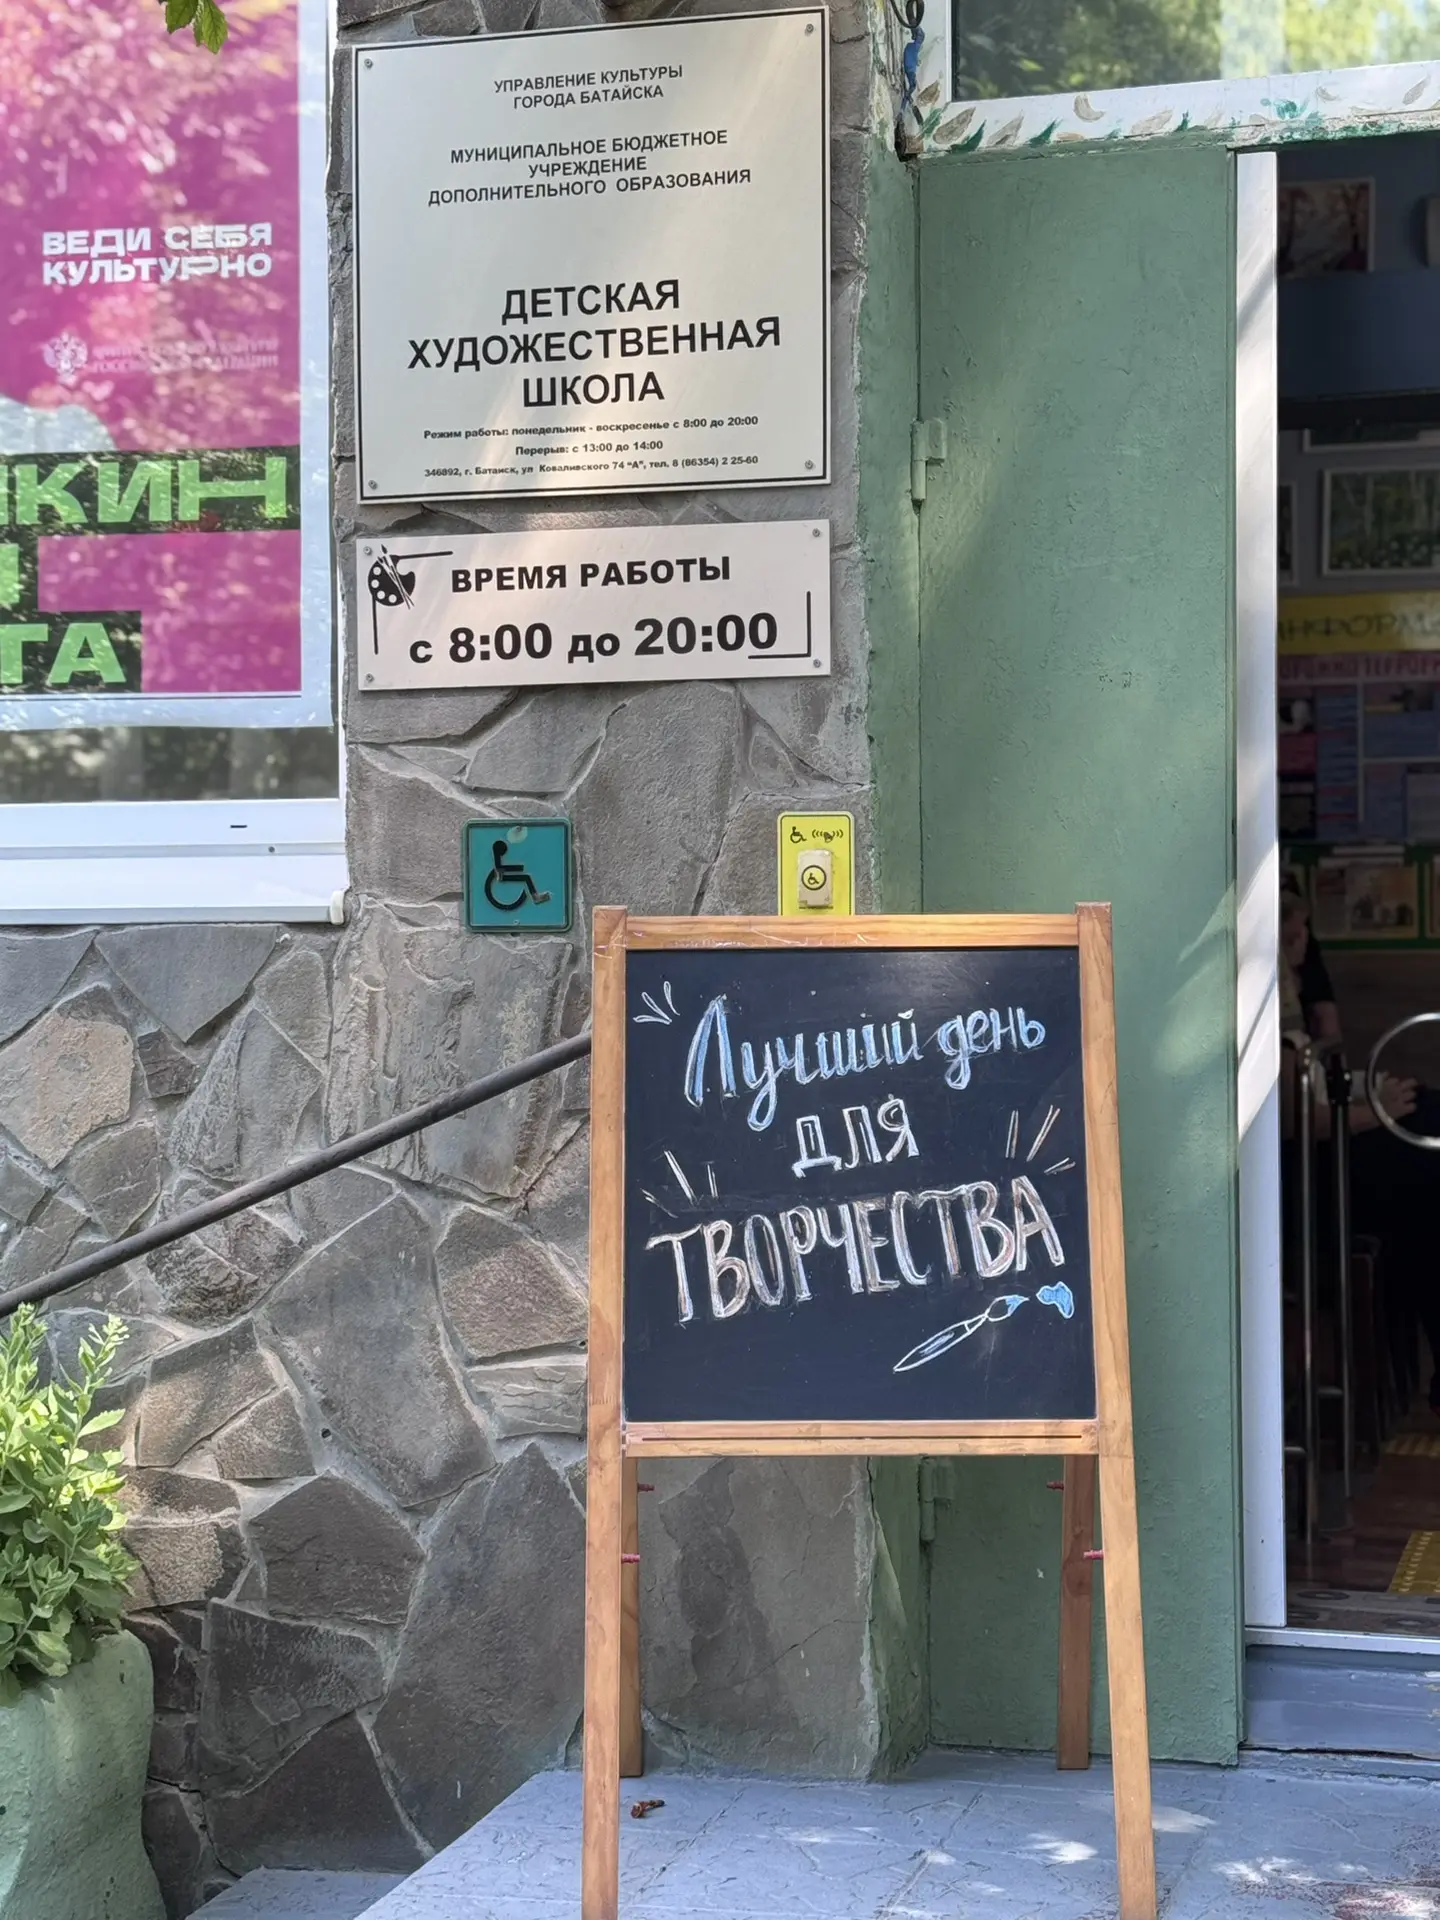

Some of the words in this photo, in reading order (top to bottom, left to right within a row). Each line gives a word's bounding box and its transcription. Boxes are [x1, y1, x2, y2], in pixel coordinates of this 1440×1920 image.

[494, 72, 597, 94] УПРАВЛЕНИЕ
[600, 64, 683, 86] КУЛЬТУРЫ
[513, 91, 576, 110] ГОРОДА
[580, 84, 664, 104] БАТАЙСКА
[450, 138, 607, 164] МУНИЦИПАЛЬНОЕ
[612, 129, 728, 153] БЮДЖЕТНОЕ
[528, 155, 647, 179] УЧРЕЖДЕНИЕ
[428, 179, 607, 207] ДОПОЛНИТЕЛЬНОГО
[615, 168, 751, 193] ОБРАЗОВАНИЯ
[42, 227, 151, 257] ВЕДИ
[164, 222, 273, 250] СЕБЯ
[42, 252, 273, 286] КУЛЬТУРНО
[501, 279, 680, 326] ДЕТСКАЯ
[407, 316, 781, 374] ХУДОЖЕСТВЕННАЯ
[522, 371, 665, 408] ШКОЛА
[423, 430, 462, 439] Режим
[464, 427, 509, 439] работы:
[511, 424, 586, 437] понедельник
[596, 421, 670, 433] воскресенье
[672, 421, 680, 429] с
[683, 418, 708, 429] 8:00
[709, 419, 725, 429] до
[727, 415, 759, 427] 20:00
[464, 468, 473, 476] г.
[611, 461, 625, 470] 74
[648, 461, 670, 469] тел.
[671, 459, 679, 468] 8
[681, 457, 719, 469] (86354)
[721, 457, 729, 466] 2
[730, 455, 759, 465] 25-60
[515, 445, 569, 457] Перерыв:
[571, 445, 579, 453] с
[582, 442, 613, 453] 13:00
[614, 443, 630, 453] до
[632, 440, 664, 451] 14:00
[0, 456, 288, 525] КИН
[451, 563, 567, 593] ВРЕМЯ
[580, 556, 731, 588] РАБОТЫ
[409, 639, 433, 663] с
[448, 622, 553, 662] 8:00
[567, 631, 621, 664] до
[633, 611, 778, 656] 20:00
[684, 994, 925, 1132] Лучший
[935, 1006, 1046, 1090] день
[645, 1175, 1066, 1326] ТВОРЧЕСТВА
